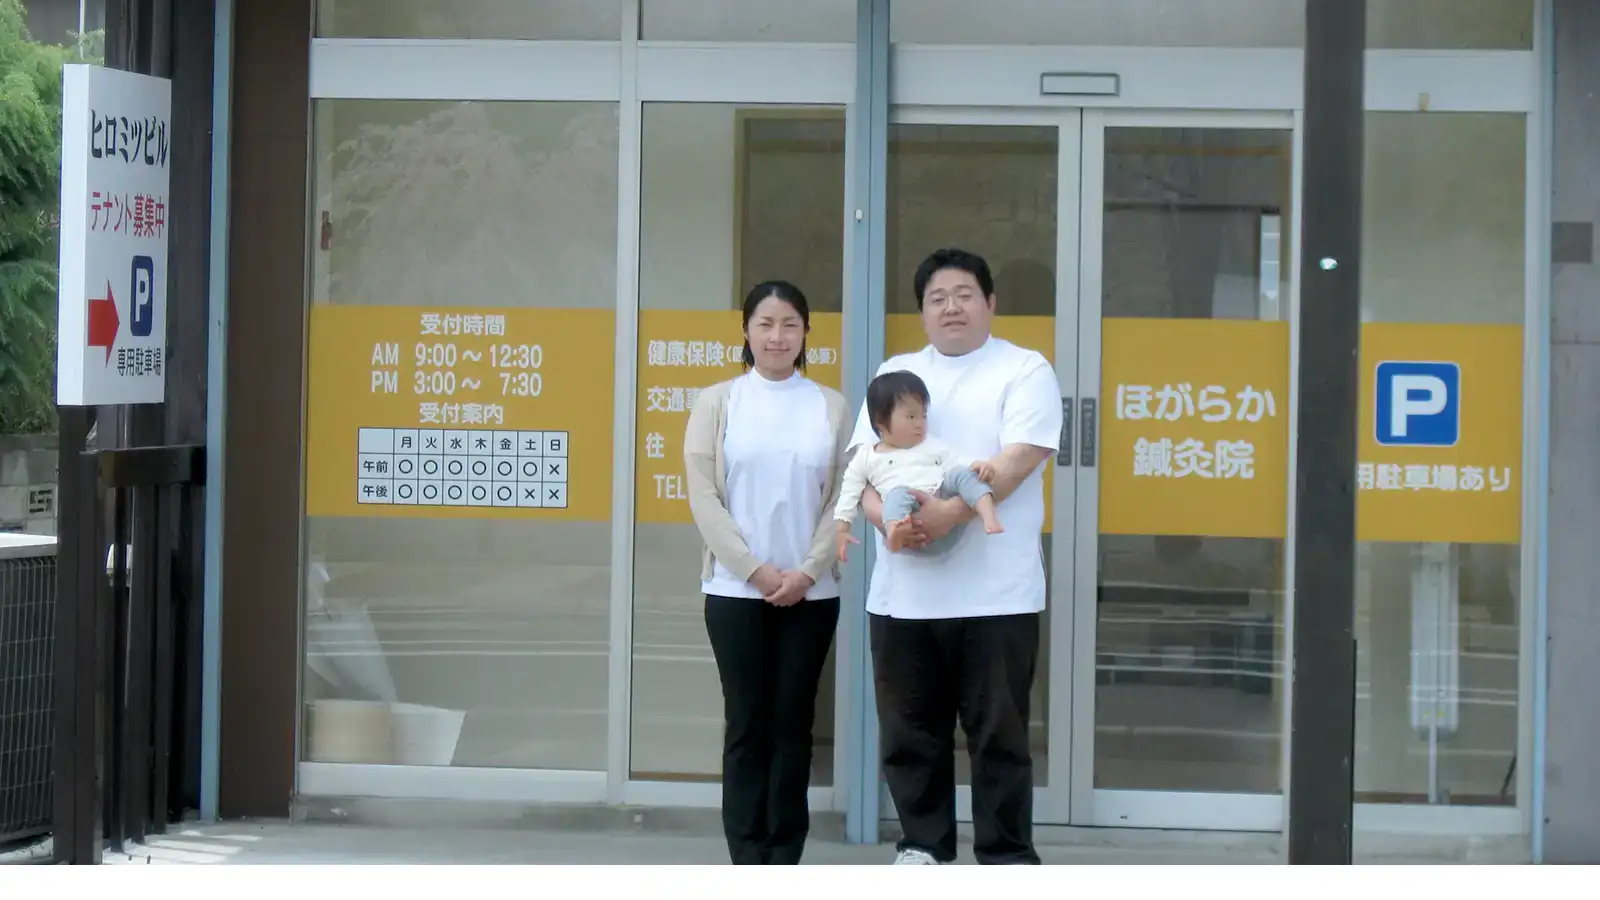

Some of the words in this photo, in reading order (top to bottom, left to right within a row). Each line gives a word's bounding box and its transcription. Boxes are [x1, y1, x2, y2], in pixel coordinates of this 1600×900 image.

[90, 108, 168, 169] ヒロミツビル
[91, 191, 165, 239] テナント募集中
[135, 267, 150, 323] P
[420, 313, 505, 336] 受付時間
[117, 346, 161, 377] 専用駐車場
[371, 342, 399, 366] AM
[371, 371, 399, 394] PM
[419, 402, 504, 425] 受付案内
[1116, 382, 1277, 422] ほがらか
[1391, 374, 1448, 437] P
[401, 436, 412, 449] 月
[425, 437, 438, 449] 火
[450, 437, 462, 450] 水
[475, 437, 487, 450] 木
[500, 438, 512, 450] 金
[524, 438, 537, 451] 土
[550, 439, 561, 451] 日
[646, 432, 665, 458] 往
[363, 460, 388, 474] 午前
[1133, 437, 1255, 479] 鍼灸院
[362, 484, 388, 498] 午後
[653, 474, 687, 499] TEL
